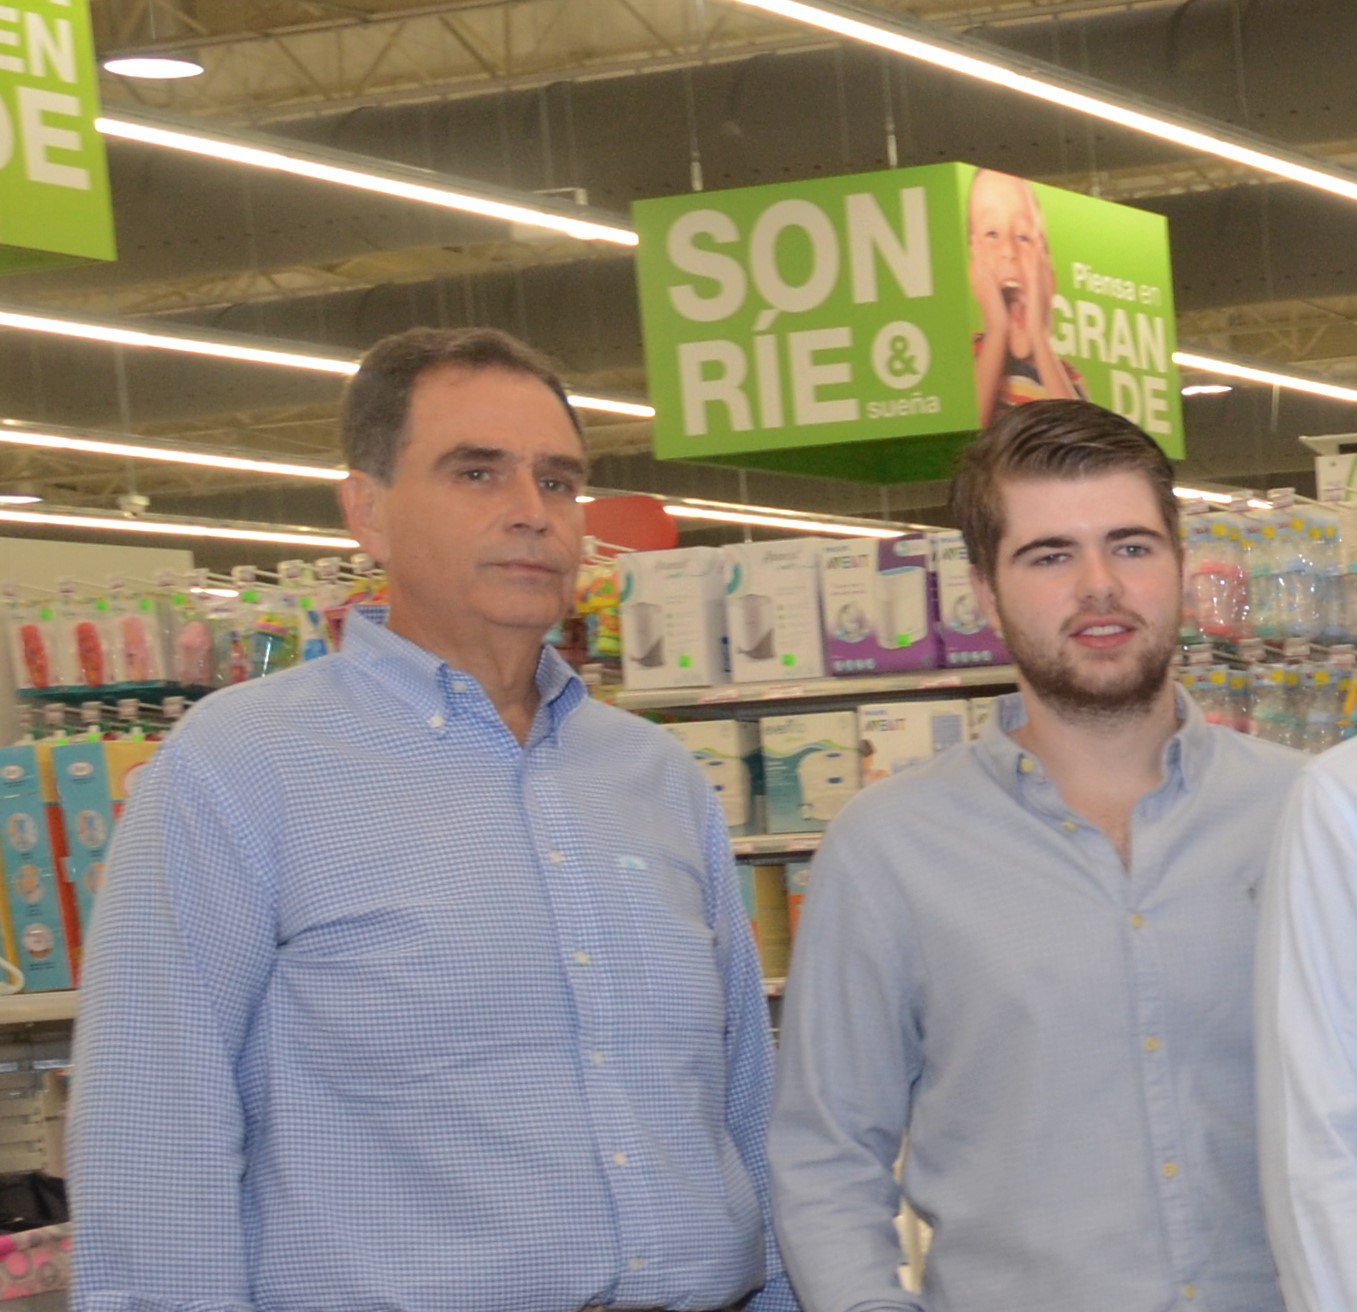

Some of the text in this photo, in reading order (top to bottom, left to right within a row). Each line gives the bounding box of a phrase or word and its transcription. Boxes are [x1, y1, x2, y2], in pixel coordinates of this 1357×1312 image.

[667, 186, 933, 322] SON
[1072, 262, 1162, 305] Piensa en
[1050, 294, 1167, 373] GRAN
[677, 308, 861, 436] RÍE
[1110, 369, 1172, 434] DE
[866, 401, 940, 421] sueña
